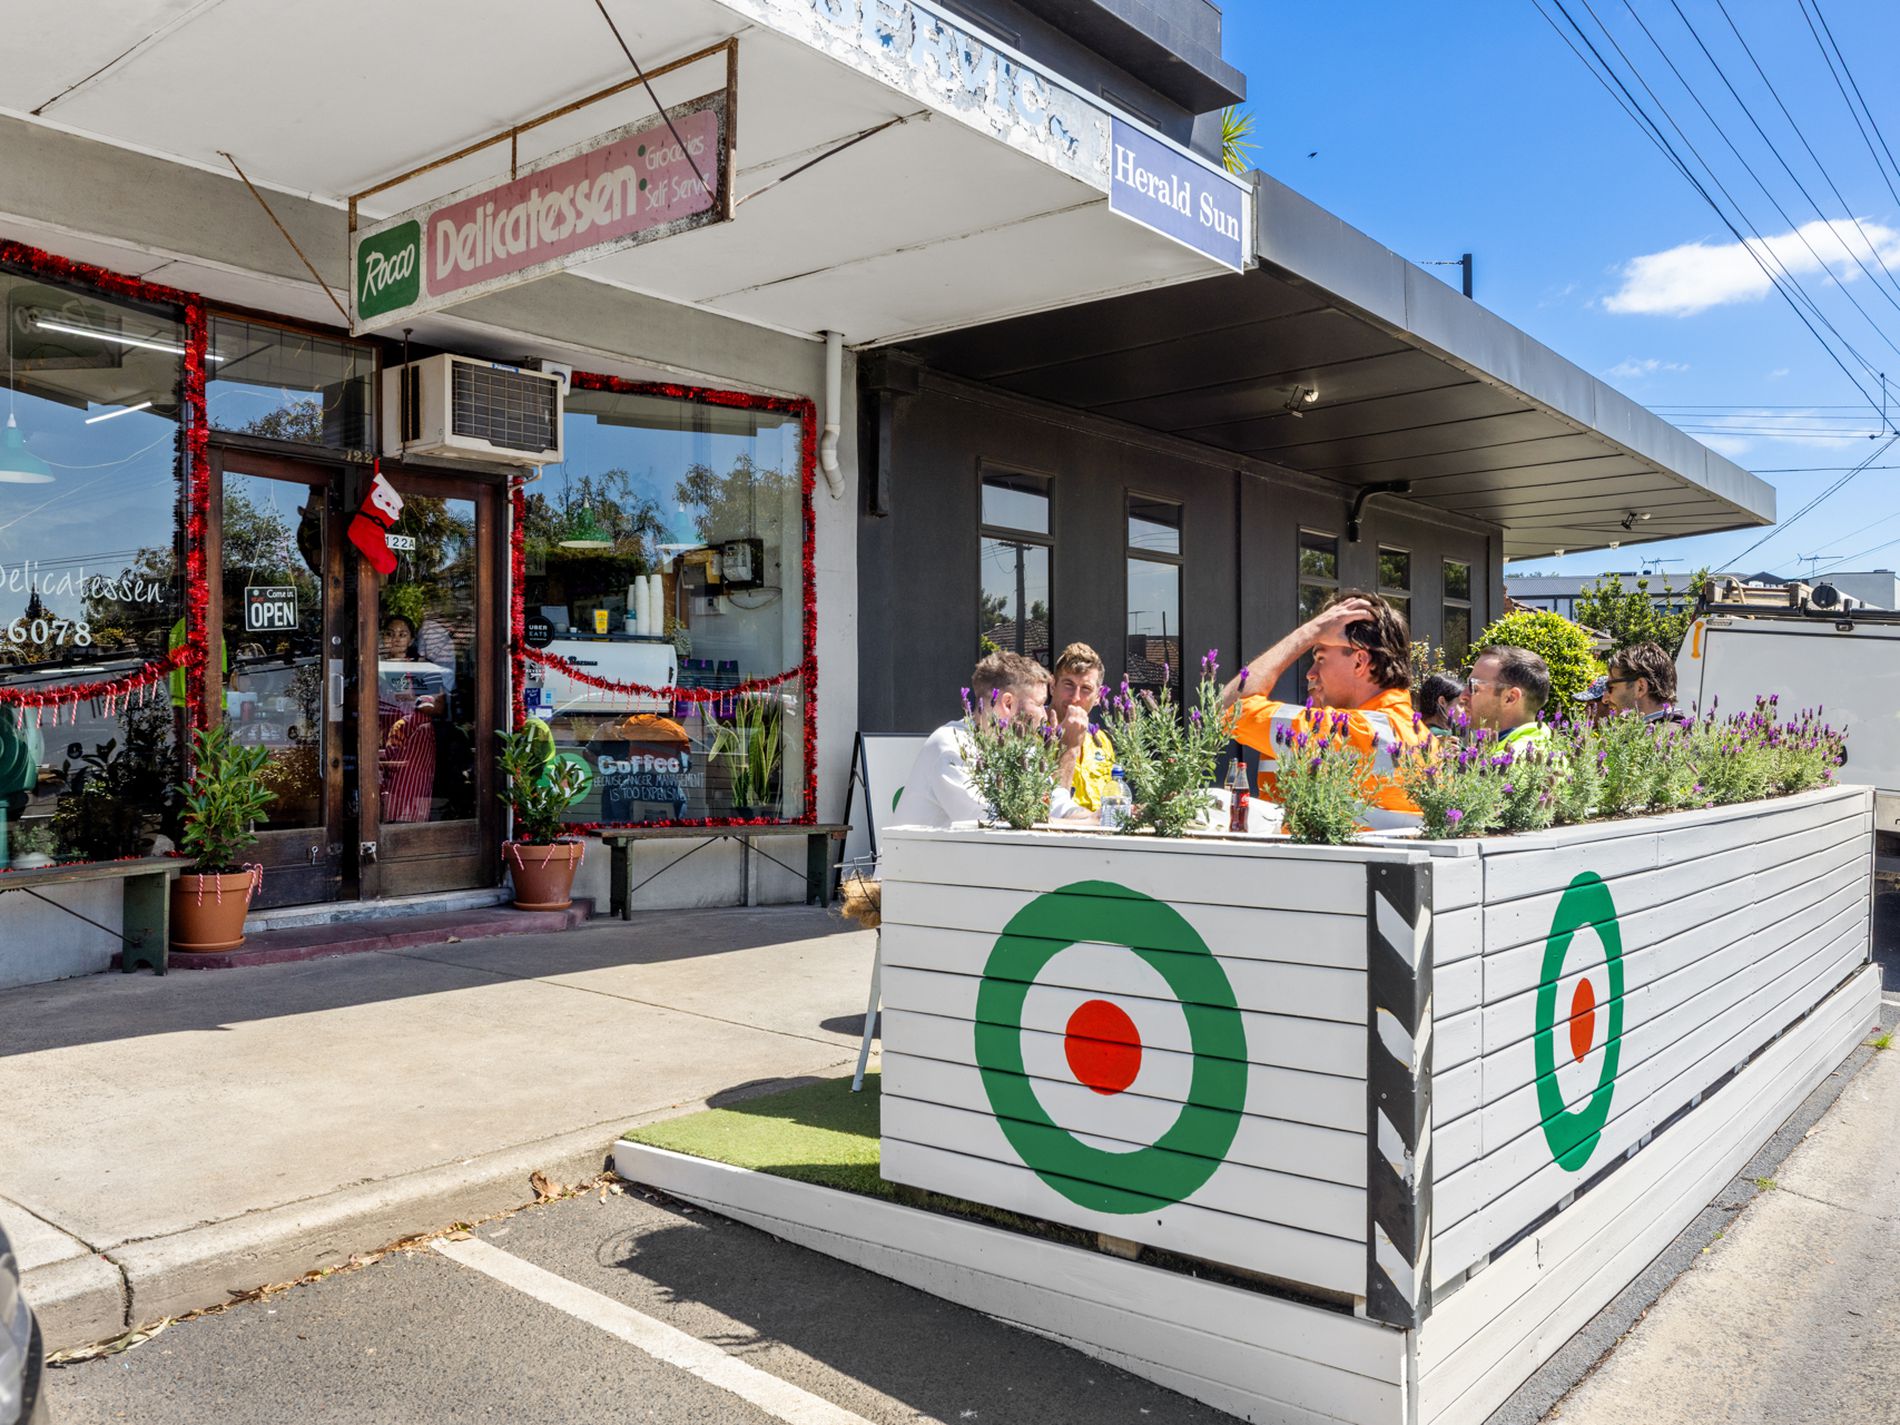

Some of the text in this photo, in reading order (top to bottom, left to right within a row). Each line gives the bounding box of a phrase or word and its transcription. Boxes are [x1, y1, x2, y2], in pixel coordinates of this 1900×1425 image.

[645, 180, 669, 212] Self
[1115, 144, 1240, 242] Herald Sun
[361, 164, 638, 303] Rocco Delicatessen
[345, 449, 374, 464] 122
[385, 536, 415, 548] 122A
[266, 589, 287, 598] Come
[251, 602, 295, 627] OPEN
[8, 616, 92, 647] 6078
[609, 788, 620, 801] IS
[621, 786, 640, 799] TOO
